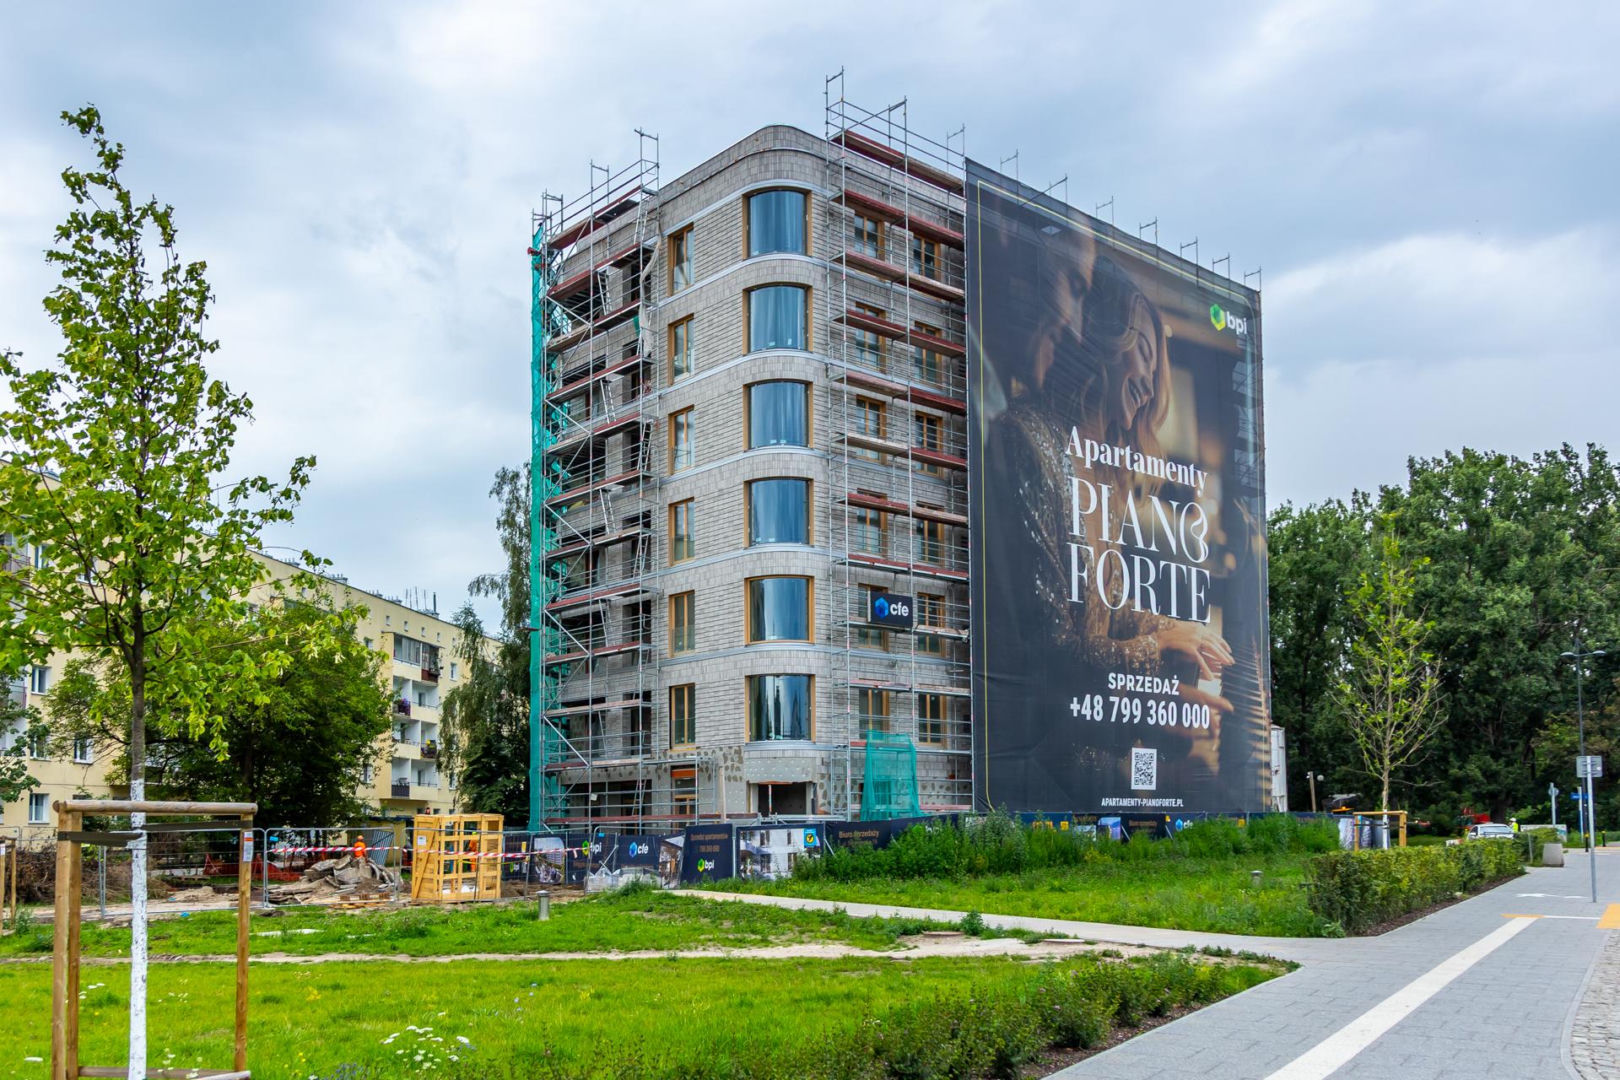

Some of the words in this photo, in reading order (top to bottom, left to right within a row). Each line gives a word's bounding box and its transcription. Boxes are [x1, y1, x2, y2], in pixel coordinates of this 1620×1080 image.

[1227, 311, 1247, 335] bpi
[1065, 426, 1208, 497] Apartamenty
[1067, 476, 1209, 563] PIANO
[1066, 542, 1211, 624] FORTE
[890, 602, 909, 617] cfe
[1108, 672, 1180, 696] SPRZEDAŻ
[1070, 694, 1104, 721] +48
[1109, 696, 1142, 724] 799
[1147, 700, 1178, 726] 360
[1182, 703, 1210, 729] 000
[1101, 797, 1184, 807] APARTAMENTY-PIANOFORTE.PL
[637, 843, 649, 854] cfe
